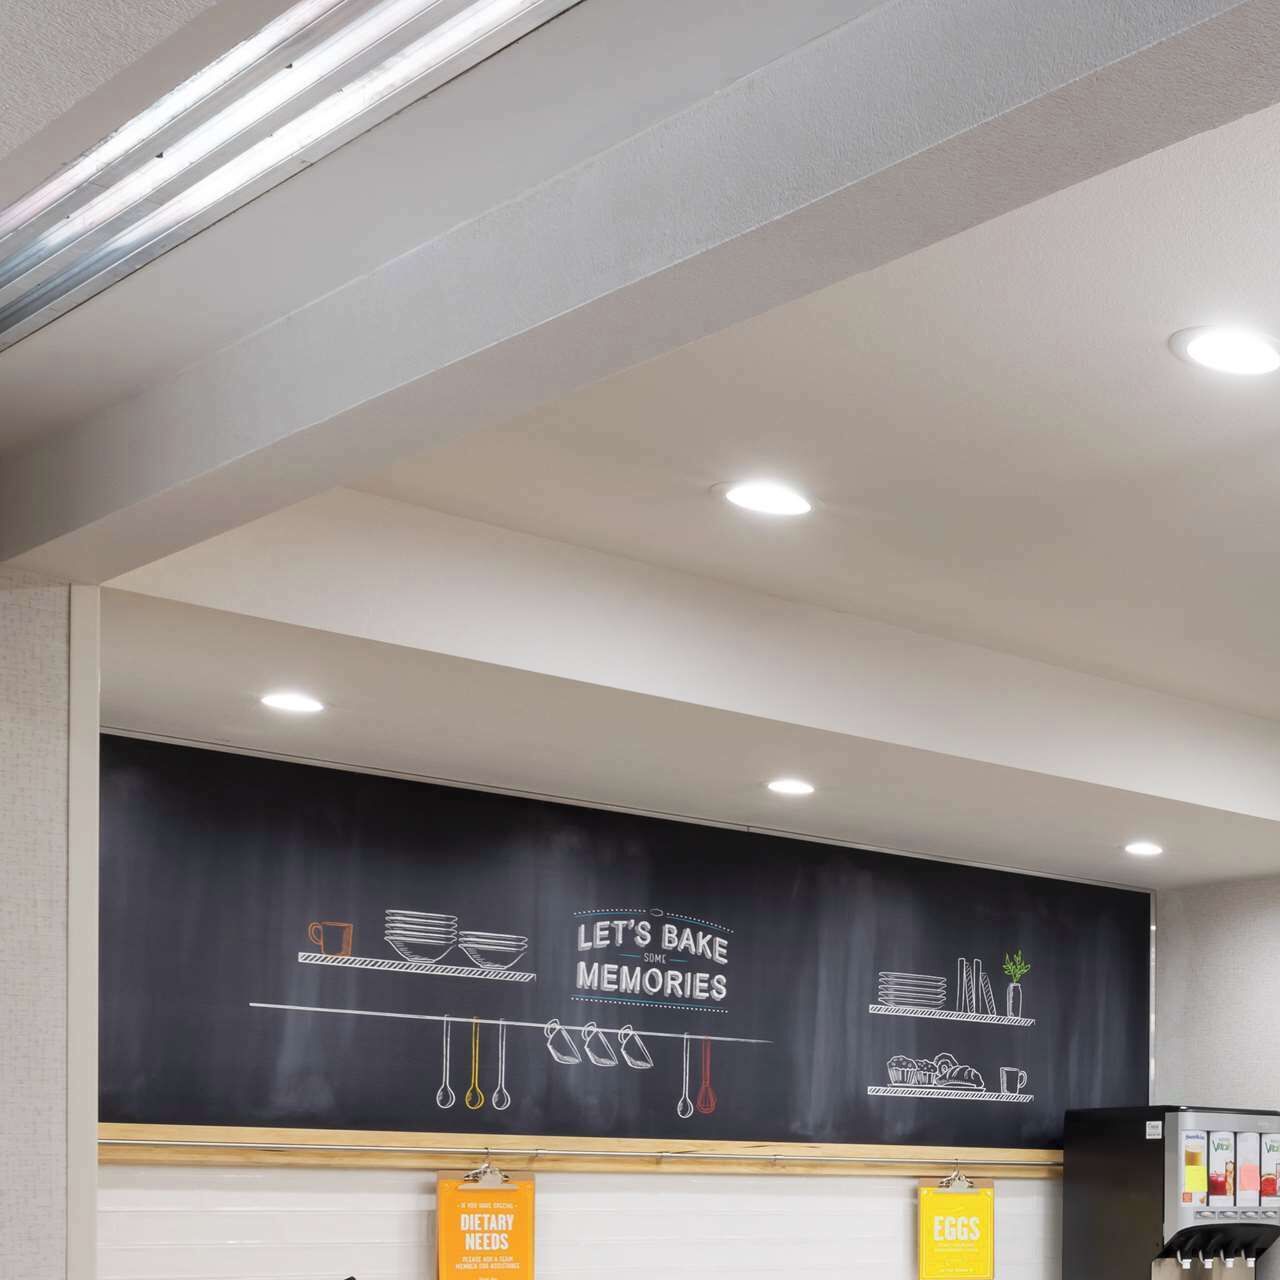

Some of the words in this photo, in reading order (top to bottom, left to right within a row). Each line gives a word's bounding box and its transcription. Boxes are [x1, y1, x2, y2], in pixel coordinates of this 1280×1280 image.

[577, 919, 651, 951] LET'S
[661, 923, 728, 965] BAKE
[644, 953, 666, 964] SOME
[576, 961, 727, 1001] MEMORIES
[460, 1214, 514, 1231] DIETARY
[933, 1215, 981, 1241] EGGS
[465, 1233, 509, 1250] NEEDS
